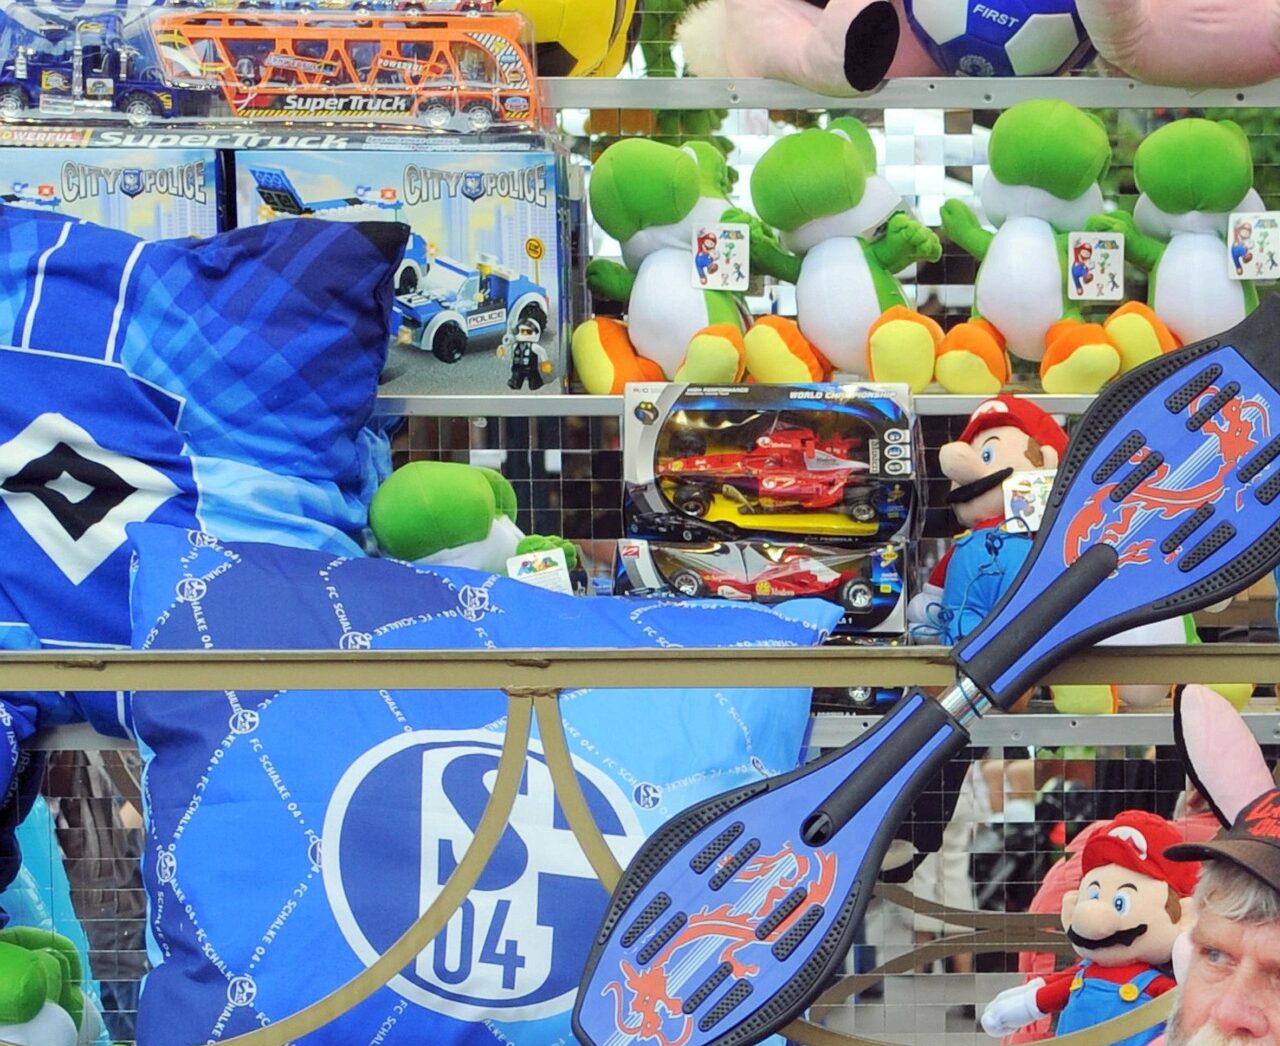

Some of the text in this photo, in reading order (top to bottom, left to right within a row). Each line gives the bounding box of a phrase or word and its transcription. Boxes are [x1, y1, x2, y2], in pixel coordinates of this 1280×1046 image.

[973, 4, 1019, 27] FIRST
[61, 159, 207, 206] CITY POLICE
[403, 161, 547, 208] CITY POLICE
[468, 311, 505, 325] POLICE
[789, 390, 822, 400] WORLD
[326, 586, 338, 599] FC
[196, 775, 209, 792] FC
[249, 737, 263, 752] FC
[258, 754, 292, 800] SCHALKE
[287, 802, 302, 819] 04
[173, 794, 203, 840] SCHALKE
[294, 881, 308, 898] FC
[261, 899, 297, 945] SCHALKE
[393, 1000, 408, 1015] FC
